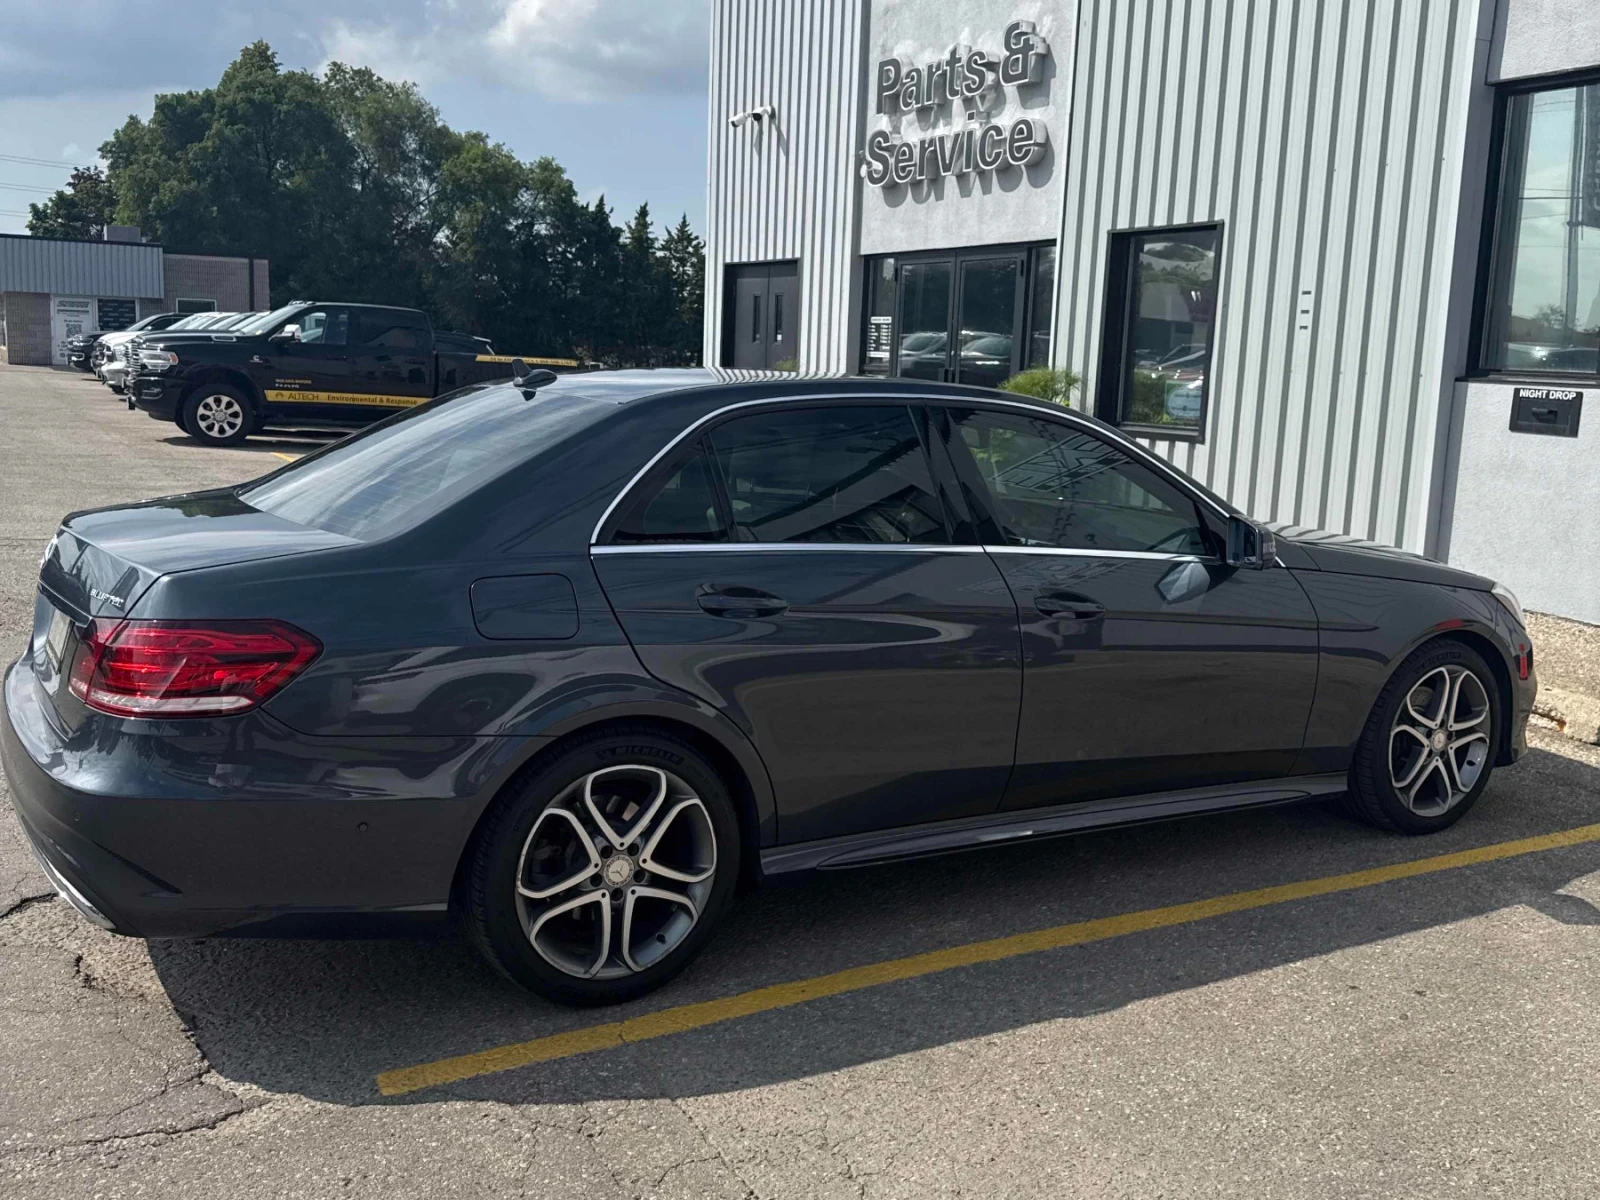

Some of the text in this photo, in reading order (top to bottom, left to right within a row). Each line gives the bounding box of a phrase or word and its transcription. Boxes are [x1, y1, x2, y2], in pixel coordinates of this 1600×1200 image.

[876, 19, 1047, 116] Parts &
[866, 111, 1041, 187] Service
[288, 392, 320, 401] ALTECH
[327, 394, 377, 404] Environmental
[385, 397, 418, 406] Response
[1519, 388, 1577, 401] NIGHT DROP
[615, 746, 682, 764] MICHELIN
